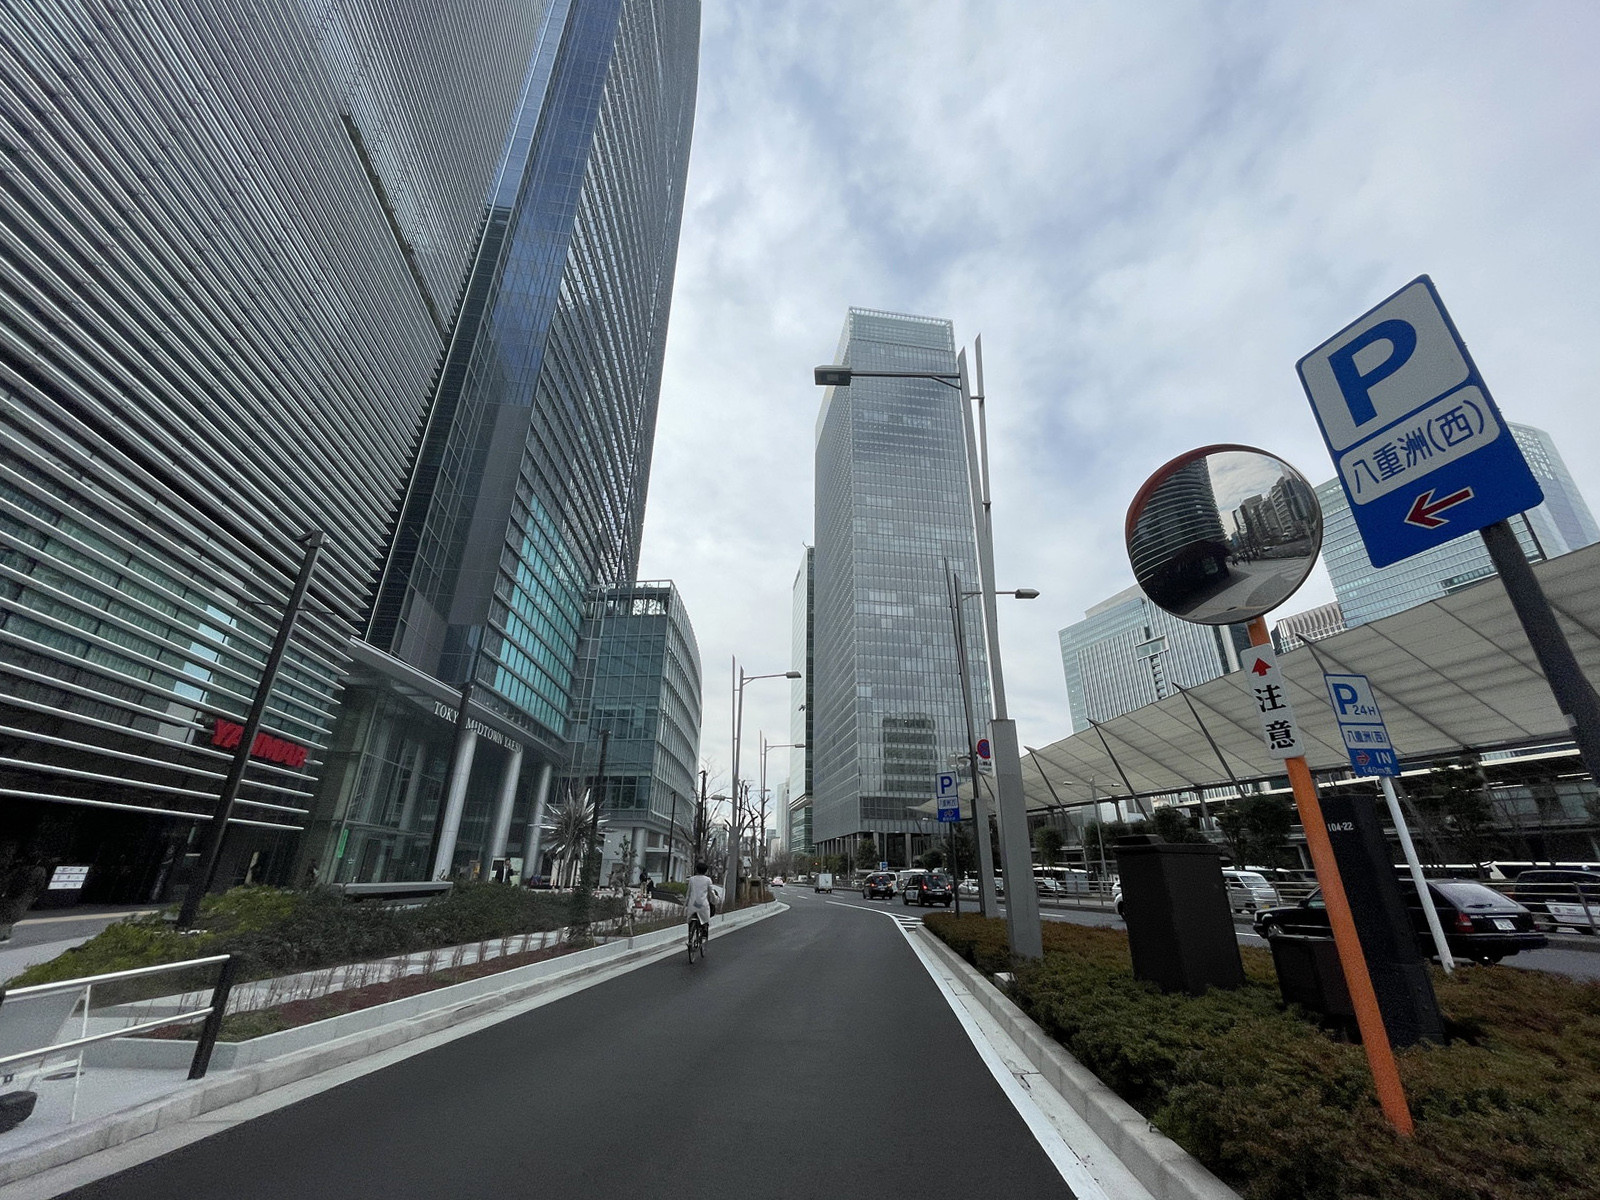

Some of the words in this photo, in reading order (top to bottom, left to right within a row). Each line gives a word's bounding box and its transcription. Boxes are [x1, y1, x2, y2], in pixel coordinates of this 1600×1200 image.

[1327, 319, 1417, 427] P
[1352, 400, 1485, 494] 八重洲(西)
[1254, 684, 1296, 750] 注意
[1332, 683, 1359, 715] P
[1353, 704, 1377, 716] 24H
[434, 701, 460, 724] TOKY
[465, 717, 503, 745] MIDTOWN
[504, 736, 523, 753] YAESU
[1375, 752, 1392, 764] IN
[940, 776, 953, 794] P
[1327, 821, 1354, 832] 104-22
